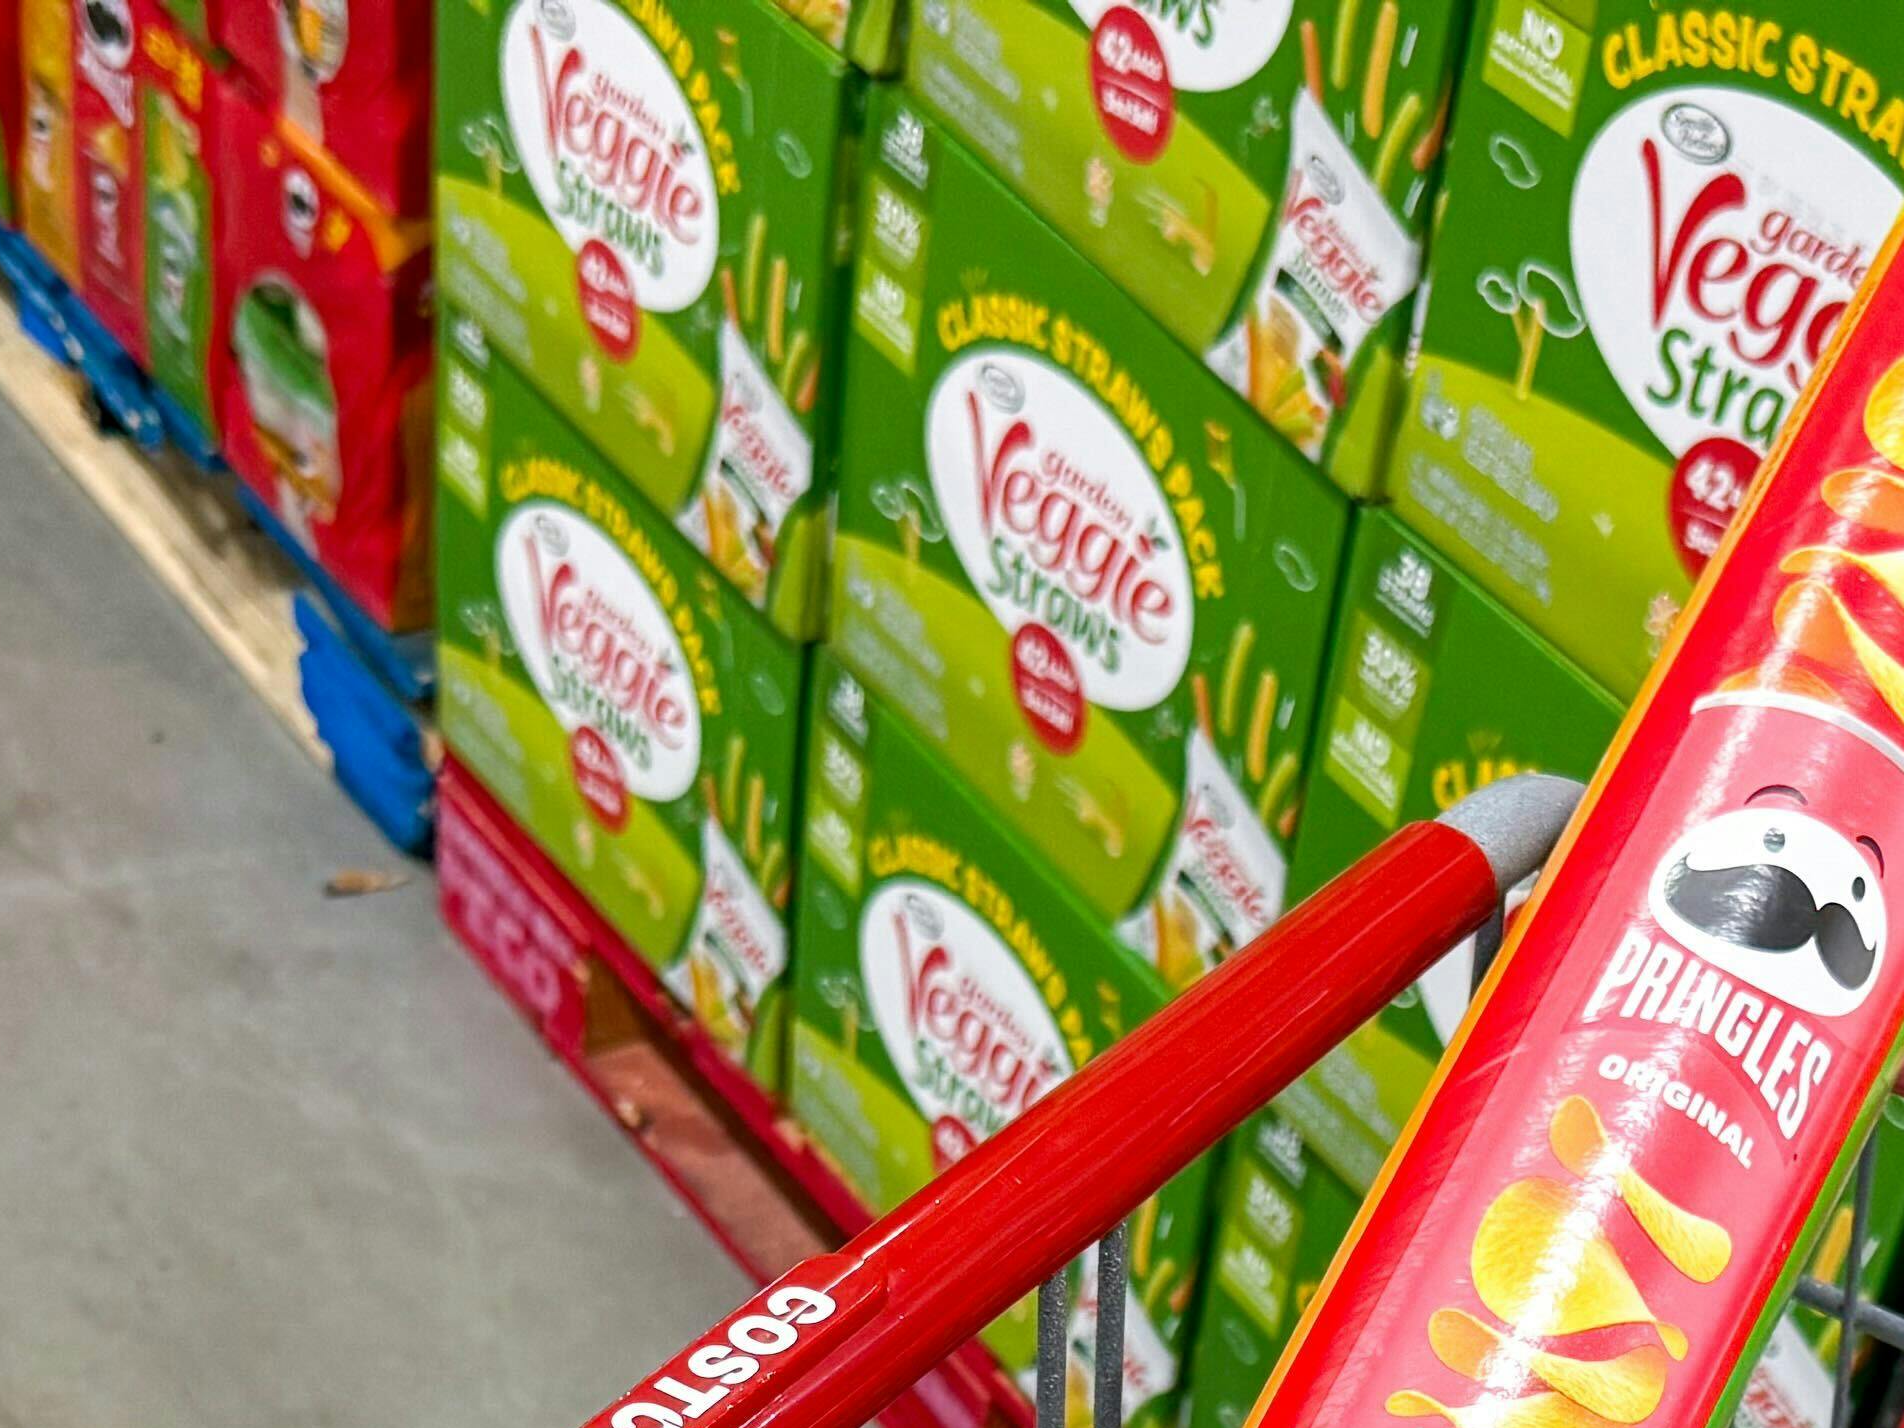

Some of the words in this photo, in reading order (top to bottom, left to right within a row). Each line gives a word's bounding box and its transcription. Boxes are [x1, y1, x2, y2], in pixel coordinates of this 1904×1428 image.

[1521, 8, 1564, 60] NO
[1602, 9, 1783, 90] CLASSIC
[530, 24, 703, 246] Veggie
[557, 159, 665, 279] Straws
[938, 294, 1047, 354] CLASSIC
[966, 389, 1173, 646] Veggie
[1039, 444, 1136, 537] garden
[524, 533, 687, 750] Veggie
[986, 537, 1124, 674] Straws
[1583, 926, 1833, 1140] PRINGLES
[1598, 1054, 1752, 1169] ORIGINAL
